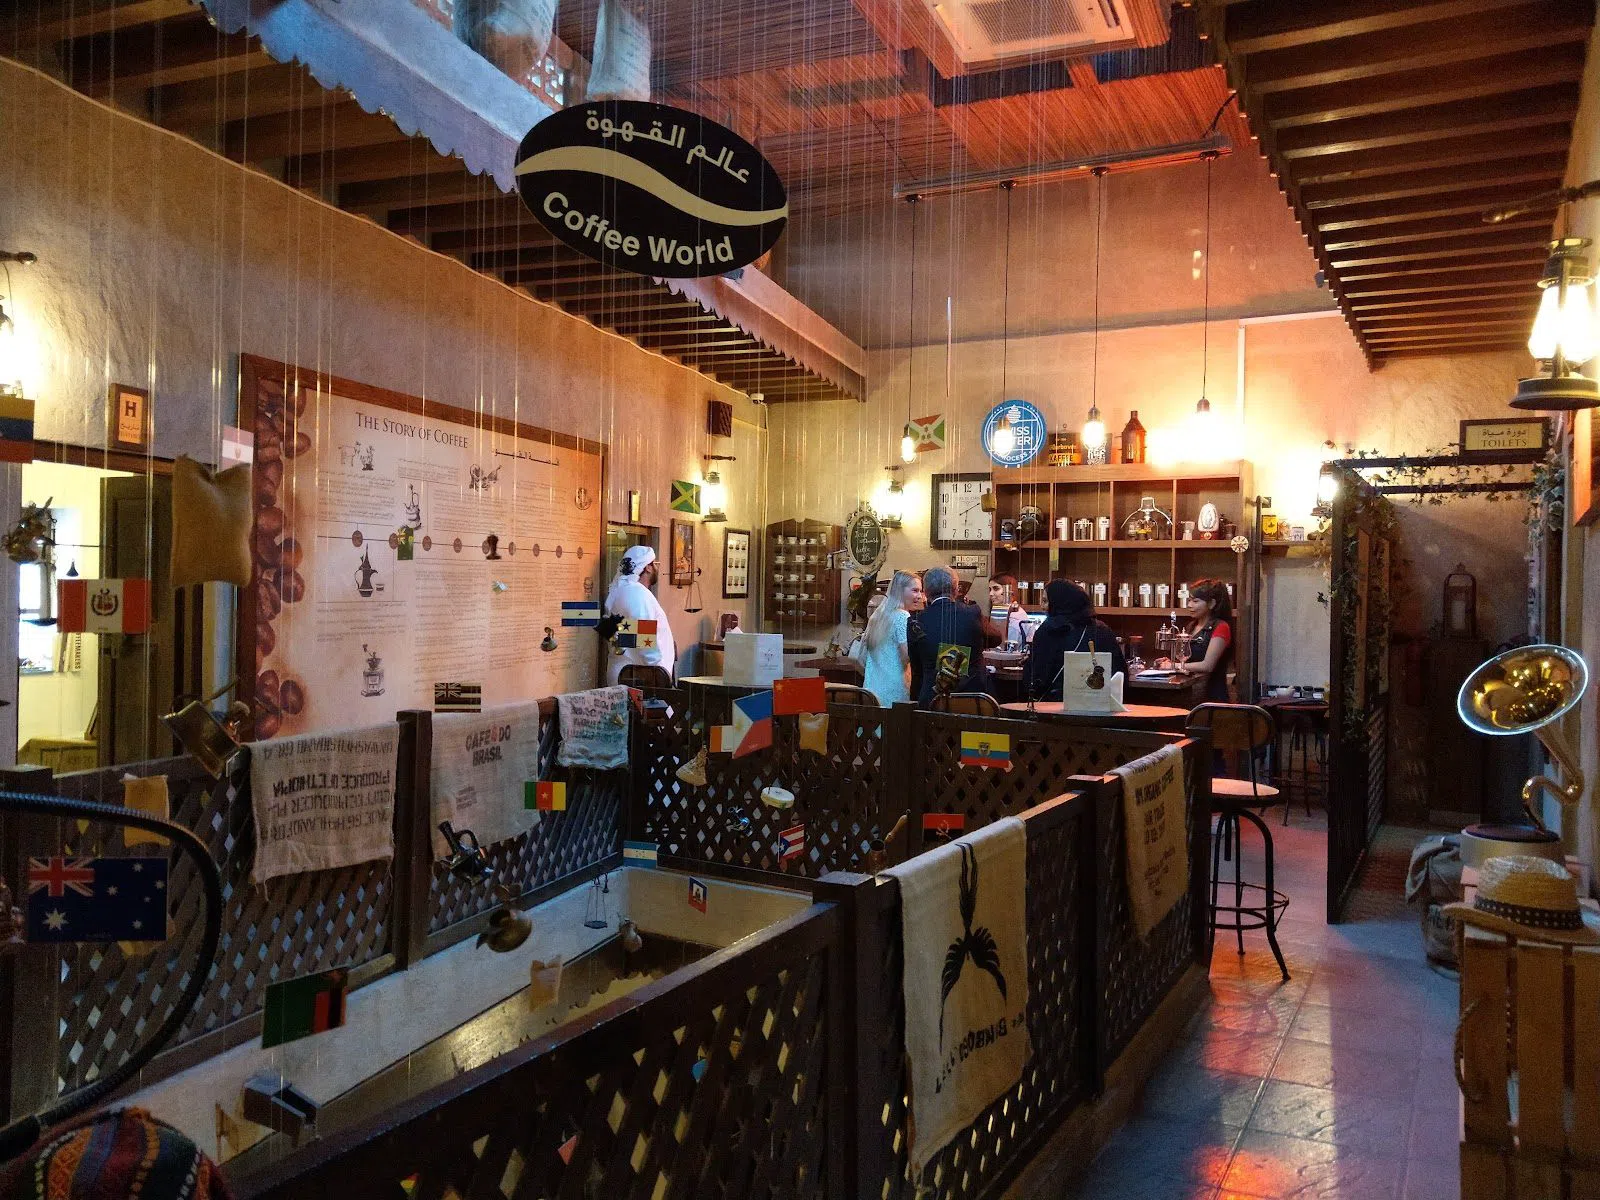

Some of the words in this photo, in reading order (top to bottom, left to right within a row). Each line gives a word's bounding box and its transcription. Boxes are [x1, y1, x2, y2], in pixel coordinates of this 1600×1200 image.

[586, 109, 686, 149] القهوة
[686, 141, 751, 184] عالم
[543, 191, 641, 257] Coffee
[648, 236, 734, 266] World
[125, 401, 137, 418] H
[355, 411, 379, 431] THE
[383, 418, 416, 438] STORY
[418, 423, 432, 441] OF
[434, 429, 468, 449] COFFEE
[1480, 438, 1528, 448] TOILETS
[1001, 451, 1028, 462] ROCESS
[964, 483, 972, 493] 12
[465, 729, 491, 752] CAFE
[498, 724, 512, 743] DO
[472, 745, 503, 768] BRASIL
[341, 769, 390, 790] PRODUCE
